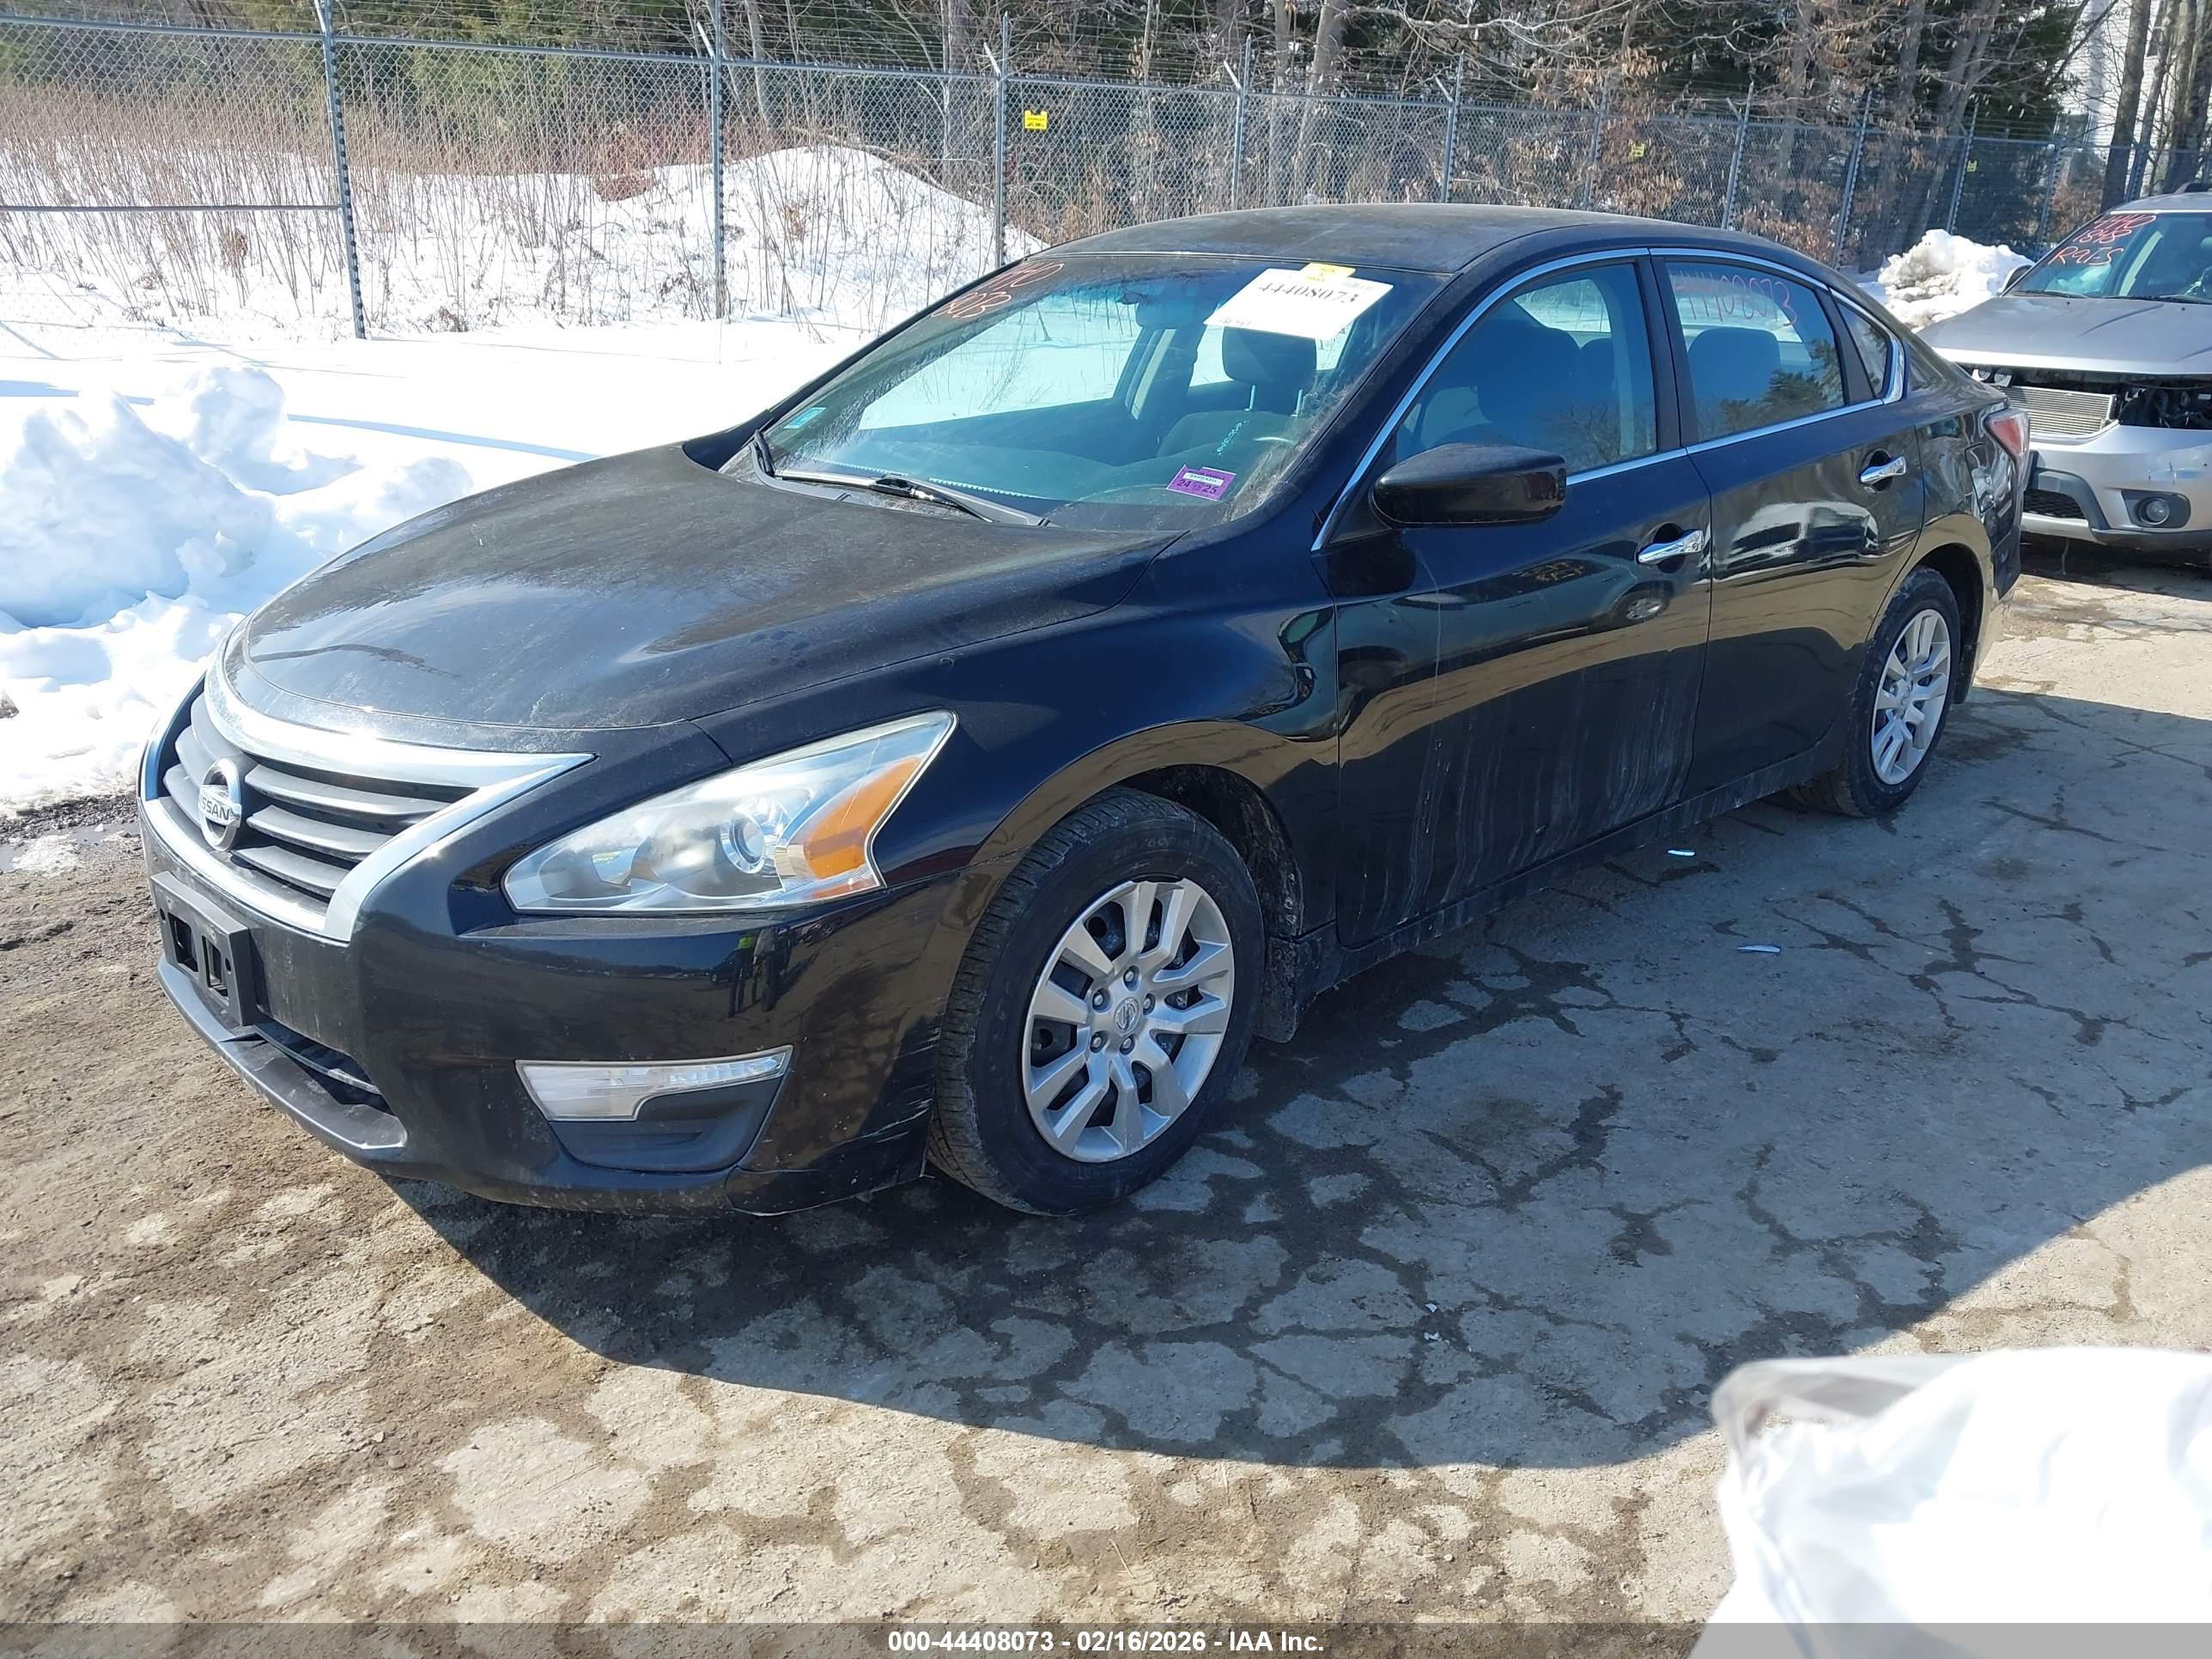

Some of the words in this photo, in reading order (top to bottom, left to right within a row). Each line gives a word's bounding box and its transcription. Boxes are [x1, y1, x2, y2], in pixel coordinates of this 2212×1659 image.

[1259, 282, 1360, 303] 44408073
[1176, 479, 1192, 488] 24
[1202, 484, 1218, 494] 25
